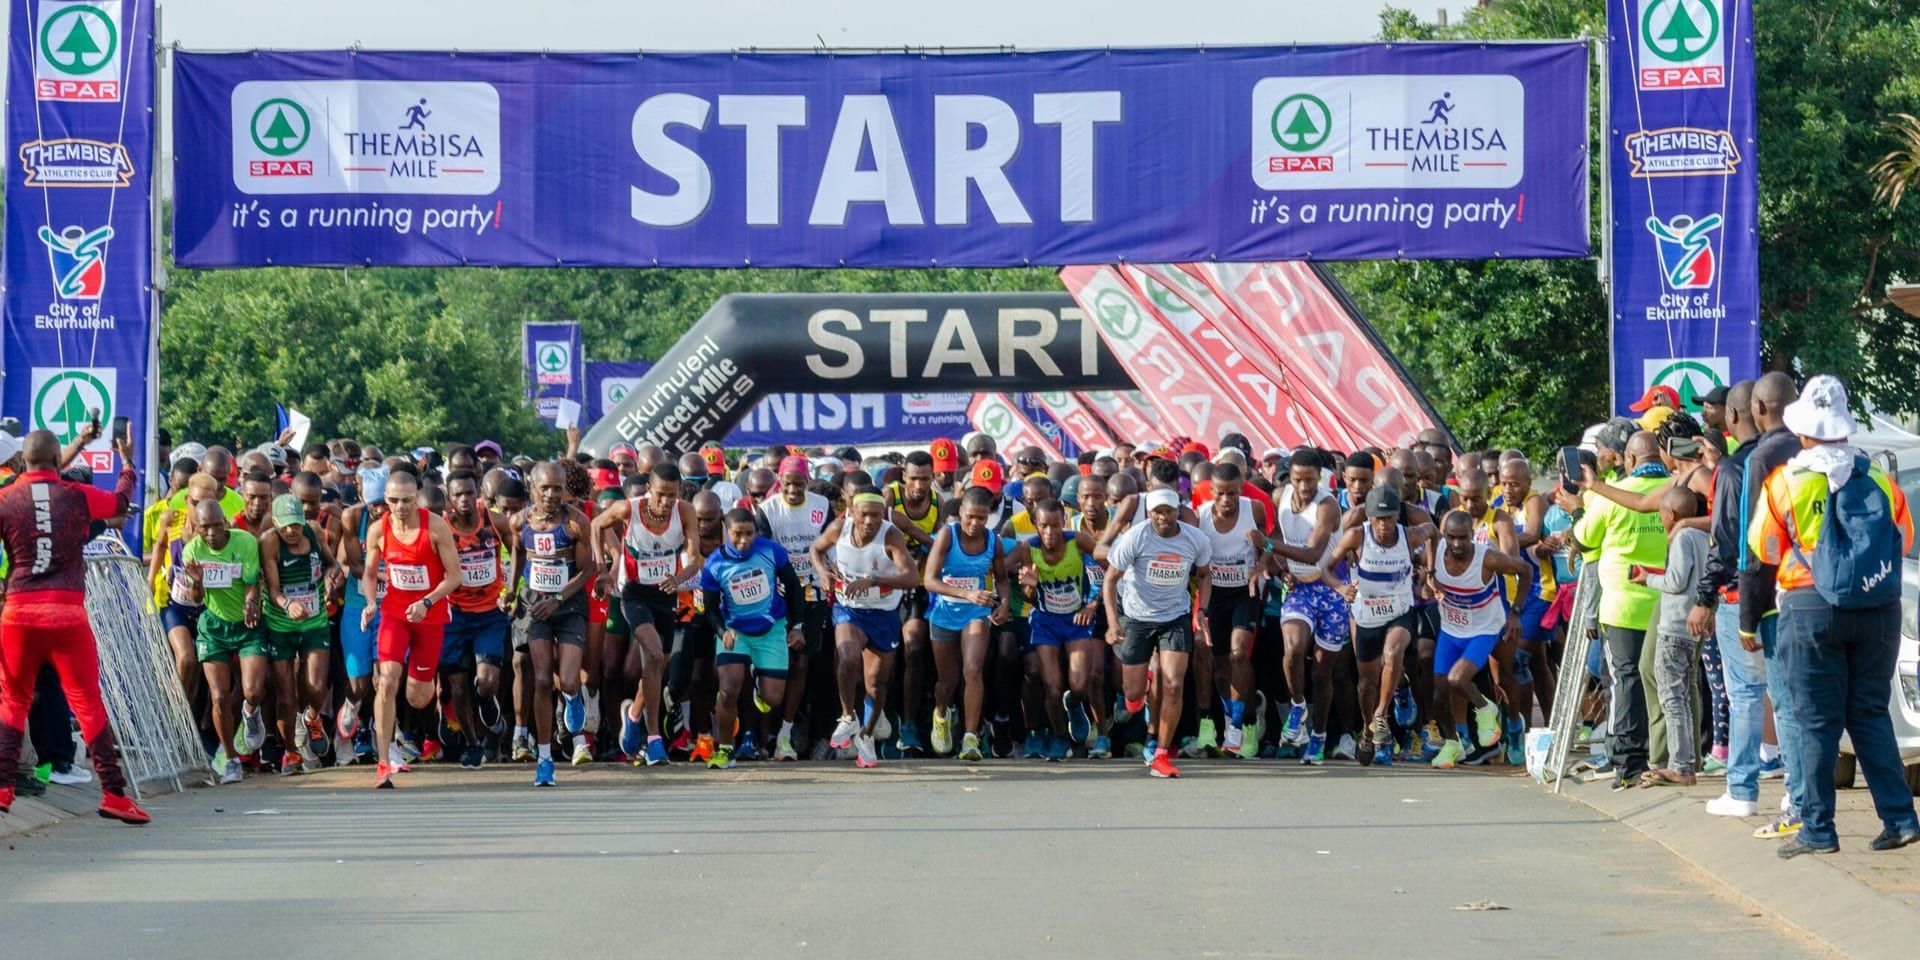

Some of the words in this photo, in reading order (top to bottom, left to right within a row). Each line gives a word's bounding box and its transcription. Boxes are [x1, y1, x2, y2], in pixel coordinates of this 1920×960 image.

[1643, 67, 1720, 86] SPAR
[39, 82, 117, 98] SPAR
[344, 132, 484, 158] THEMBISA
[1365, 127, 1507, 151] THEMBISA
[1631, 132, 1734, 158] THEMBISA
[26, 143, 128, 170] THEMBISA
[631, 91, 1122, 225] START
[1270, 157, 1333, 172] SPAR
[1411, 154, 1460, 172] MILE
[1648, 157, 1695, 168] ATHLETICS
[1696, 157, 1719, 166] CLUB
[43, 166, 88, 179] ATHLETICS
[89, 166, 113, 178] CLUB
[250, 161, 312, 176] SPAR
[389, 160, 438, 178] MILE
[232, 199, 271, 228] it's
[280, 208, 298, 228] a
[308, 202, 411, 234] running
[422, 199, 502, 236] party!
[1250, 195, 1291, 225] it's
[1300, 203, 1318, 223] a
[1328, 196, 1434, 229] running
[1444, 193, 1524, 229] party!
[1660, 293, 1690, 309] City
[1693, 292, 1709, 306] of
[49, 302, 78, 317] City
[82, 302, 99, 317] of
[1645, 304, 1726, 321] Ekurhuleni
[34, 314, 115, 329] Ekurhuleni
[804, 307, 1098, 379] START
[615, 335, 720, 441] Ekurhuleni
[689, 357, 738, 404] Mile
[673, 373, 755, 455] ERIES
[928, 413, 965, 427] running
[811, 510, 824, 524] 60
[1629, 525, 1665, 535] running
[537, 537, 552, 551] 50
[394, 572, 425, 585] 1944
[467, 568, 490, 581] 1425
[535, 573, 562, 586] SIPHO
[1148, 567, 1185, 579] THABANG
[1208, 569, 1246, 582] SAMUEL
[740, 583, 762, 599] 1307
[1370, 604, 1394, 617] 1494
